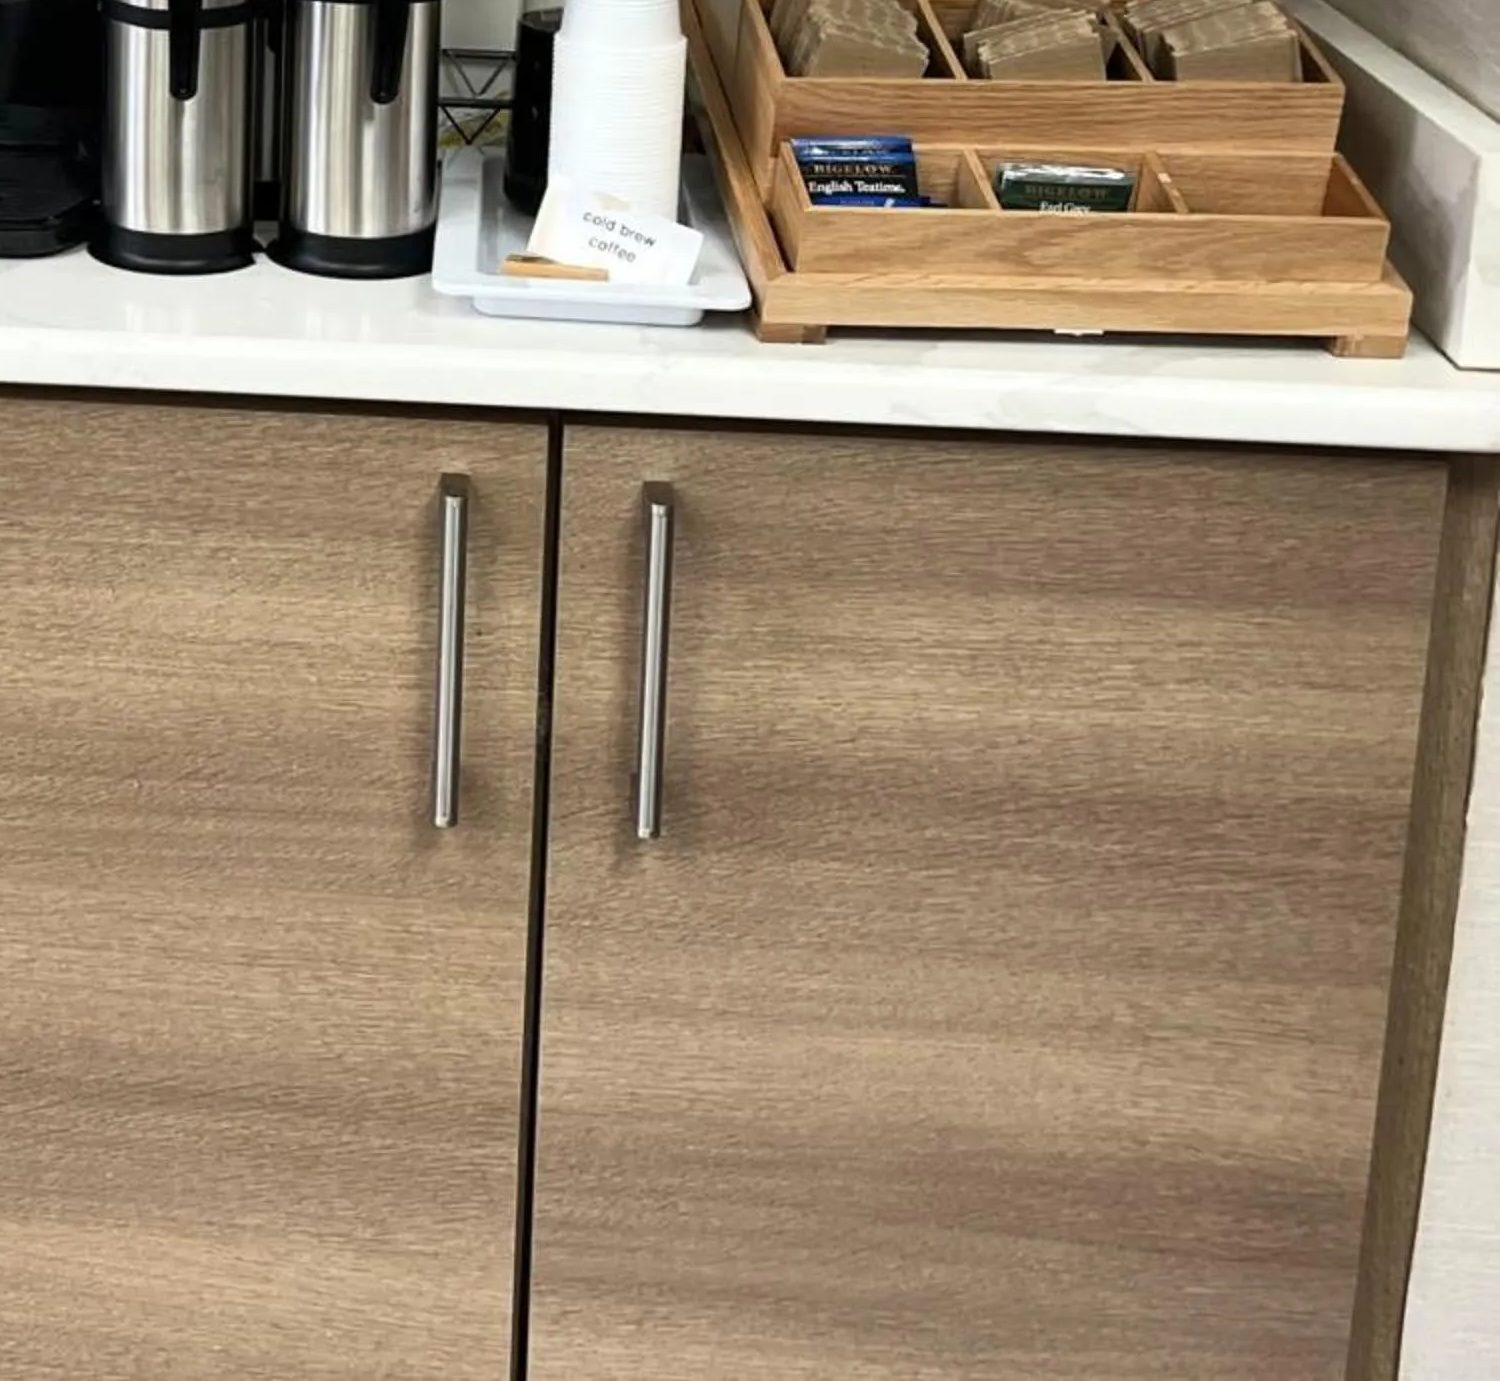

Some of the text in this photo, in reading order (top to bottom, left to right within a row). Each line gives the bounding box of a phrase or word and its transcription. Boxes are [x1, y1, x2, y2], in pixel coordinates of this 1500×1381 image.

[808, 179, 853, 195] English
[583, 211, 657, 247] cold brew
[588, 237, 636, 263] coffee
